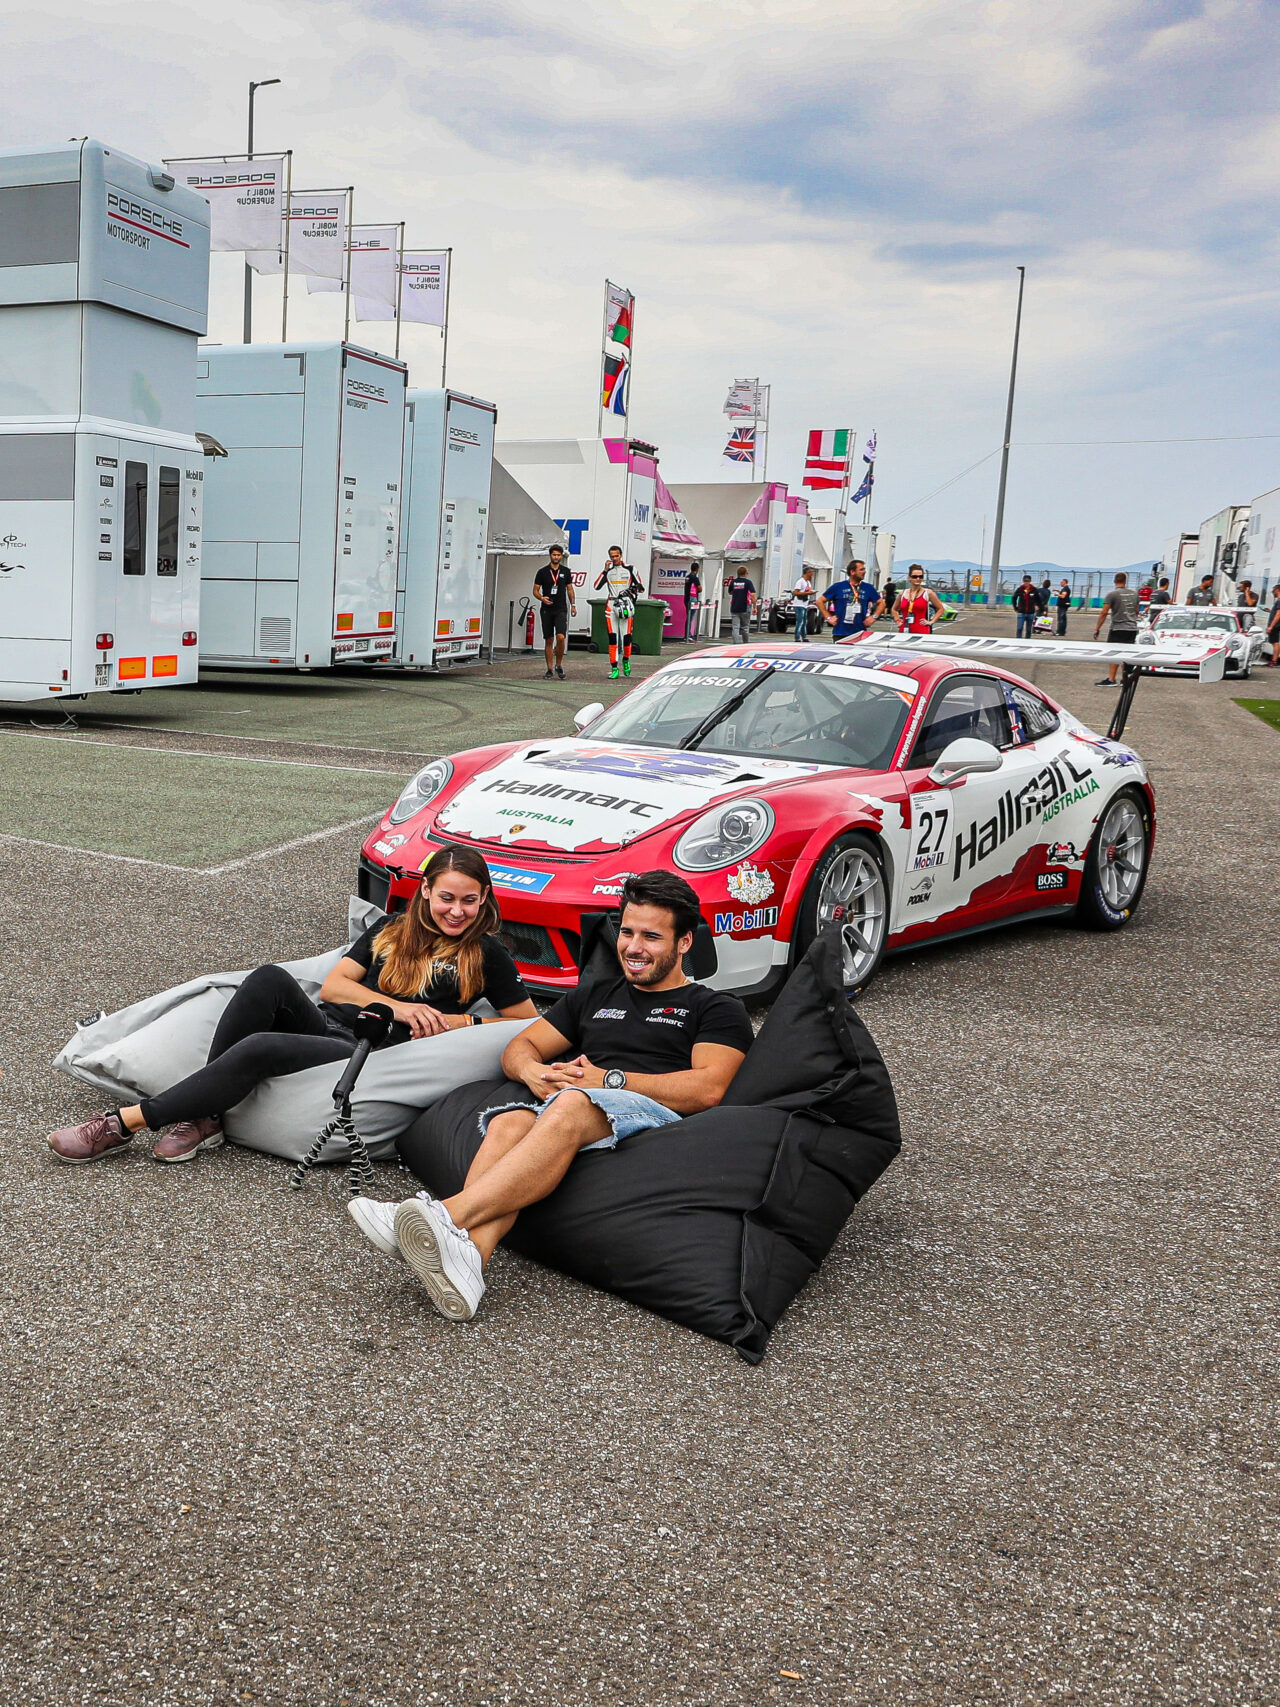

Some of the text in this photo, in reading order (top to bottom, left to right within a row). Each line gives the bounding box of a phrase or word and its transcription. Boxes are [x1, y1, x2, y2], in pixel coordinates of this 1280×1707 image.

[108, 193, 183, 237] PORSCHE
[107, 222, 150, 250] MOTORSPORT
[347, 379, 385, 397] PORSCHE
[450, 427, 478, 441] PORSCHE
[729, 658, 801, 671] Mobil
[652, 674, 747, 689] Mawson
[481, 779, 663, 818] Hallmarc
[1041, 778, 1100, 825] AUSTRALIA
[496, 808, 574, 826] AUSTRALIA
[953, 749, 1093, 882] Hallmarc
[917, 809, 948, 855] 27
[913, 855, 935, 869] Mobil
[1038, 873, 1063, 885] BOSS
[715, 909, 763, 933] Mobil
[651, 1007, 689, 1017] GROVE
[645, 1016, 684, 1028] Hallmarc
